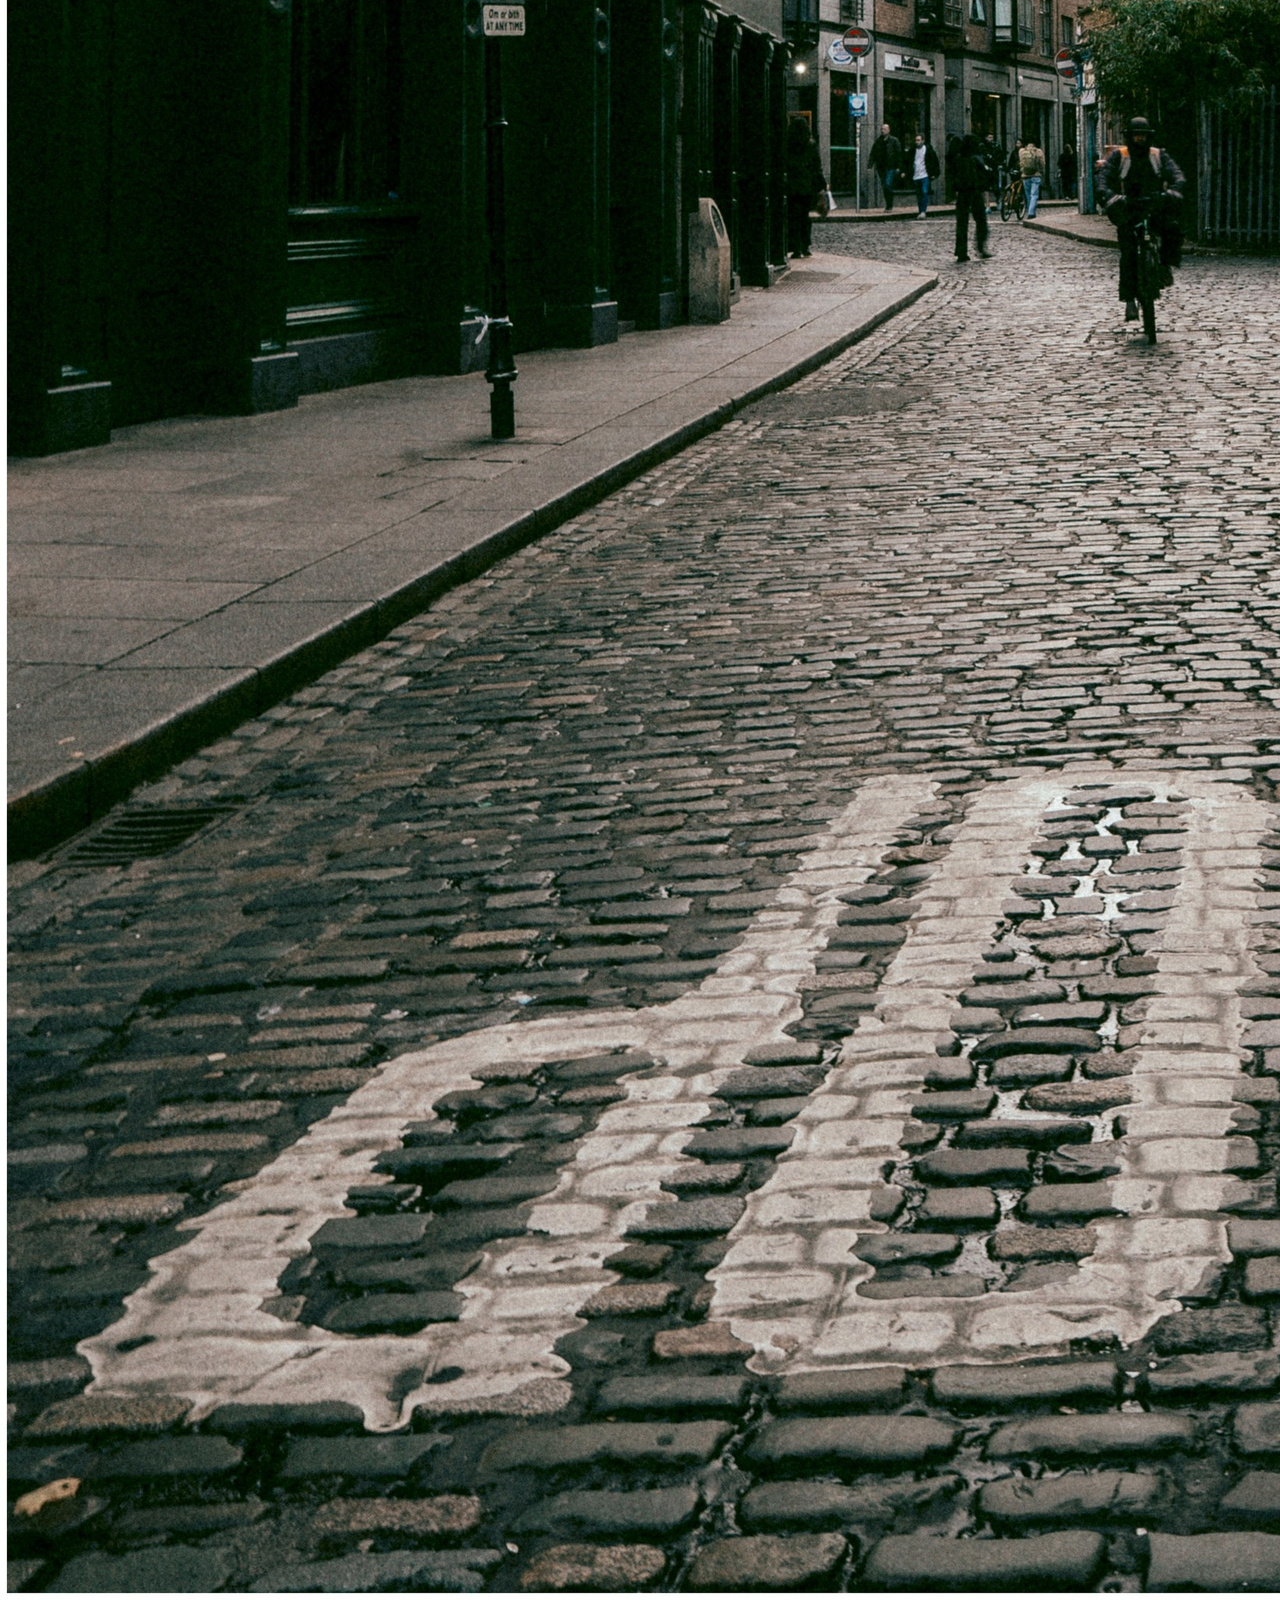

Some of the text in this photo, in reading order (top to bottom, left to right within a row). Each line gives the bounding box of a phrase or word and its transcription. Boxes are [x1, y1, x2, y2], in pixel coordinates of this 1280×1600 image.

[486, 21, 524, 32] AT ANY TIME
